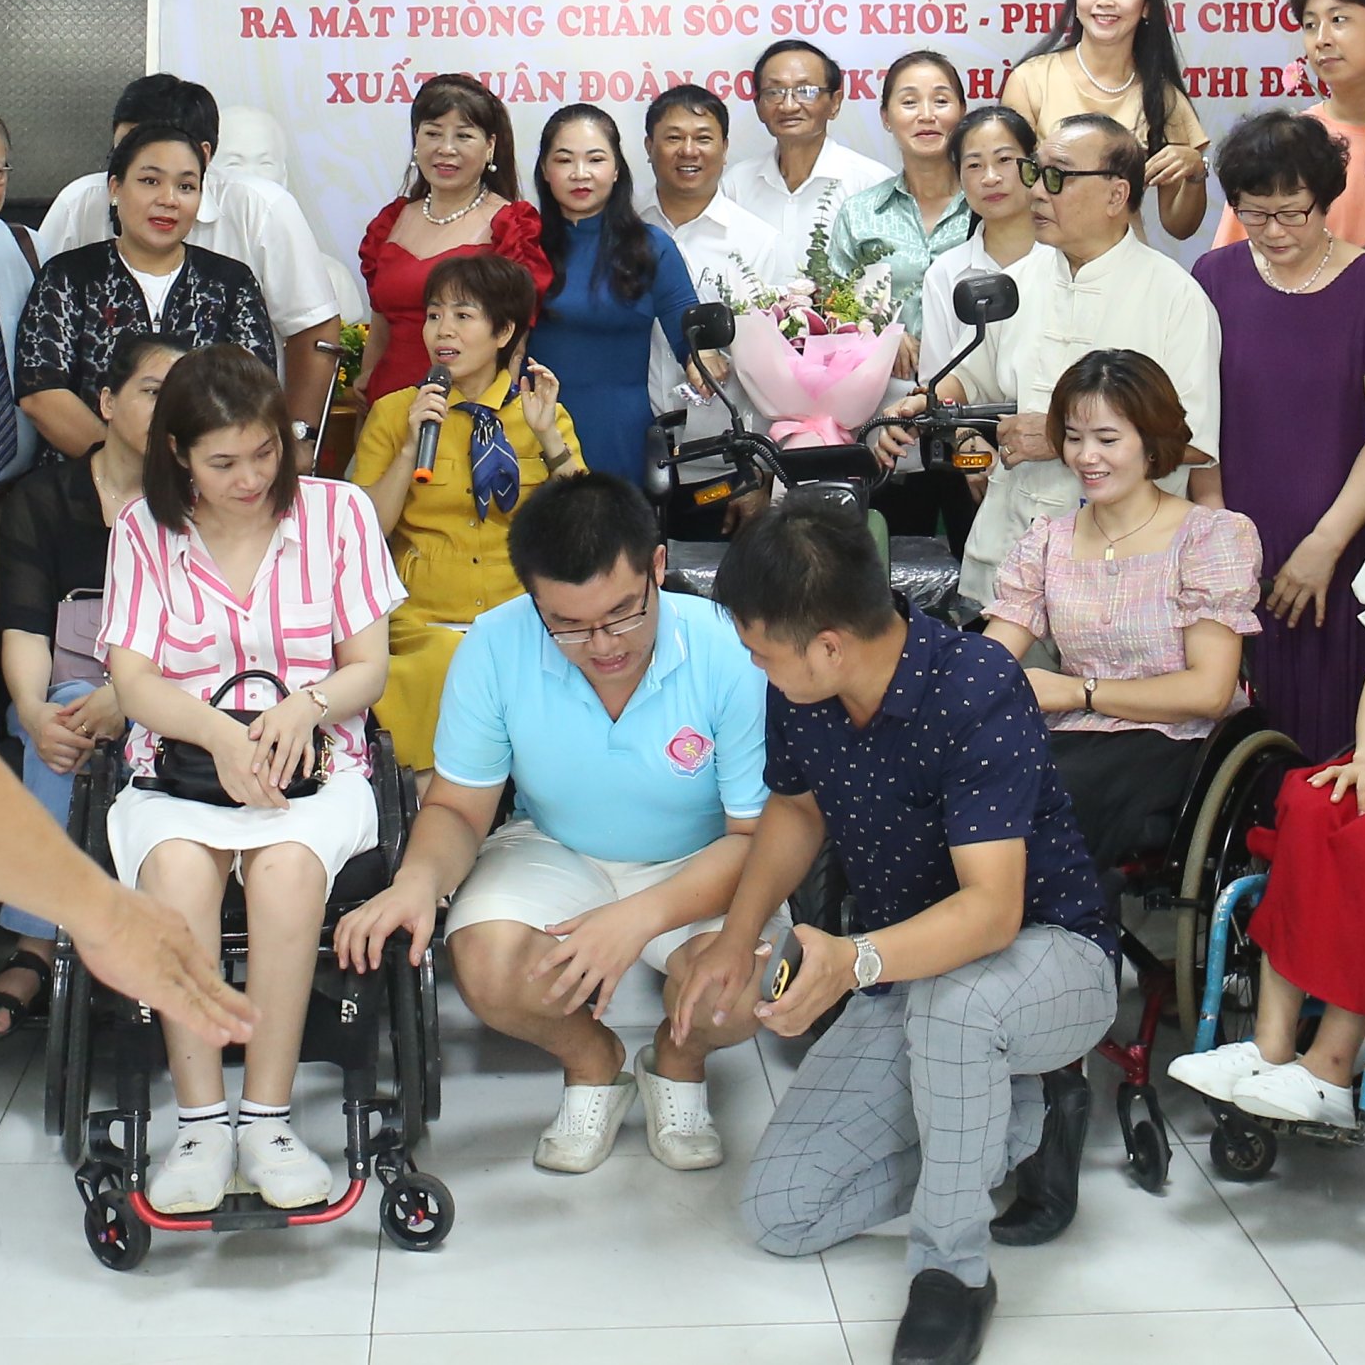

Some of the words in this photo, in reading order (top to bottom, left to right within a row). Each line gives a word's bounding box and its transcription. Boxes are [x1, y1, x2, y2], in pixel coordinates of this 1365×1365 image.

[241, 6, 297, 38] RA
[460, 62, 567, 103] UÂN
[1182, 66, 1248, 98] THI
